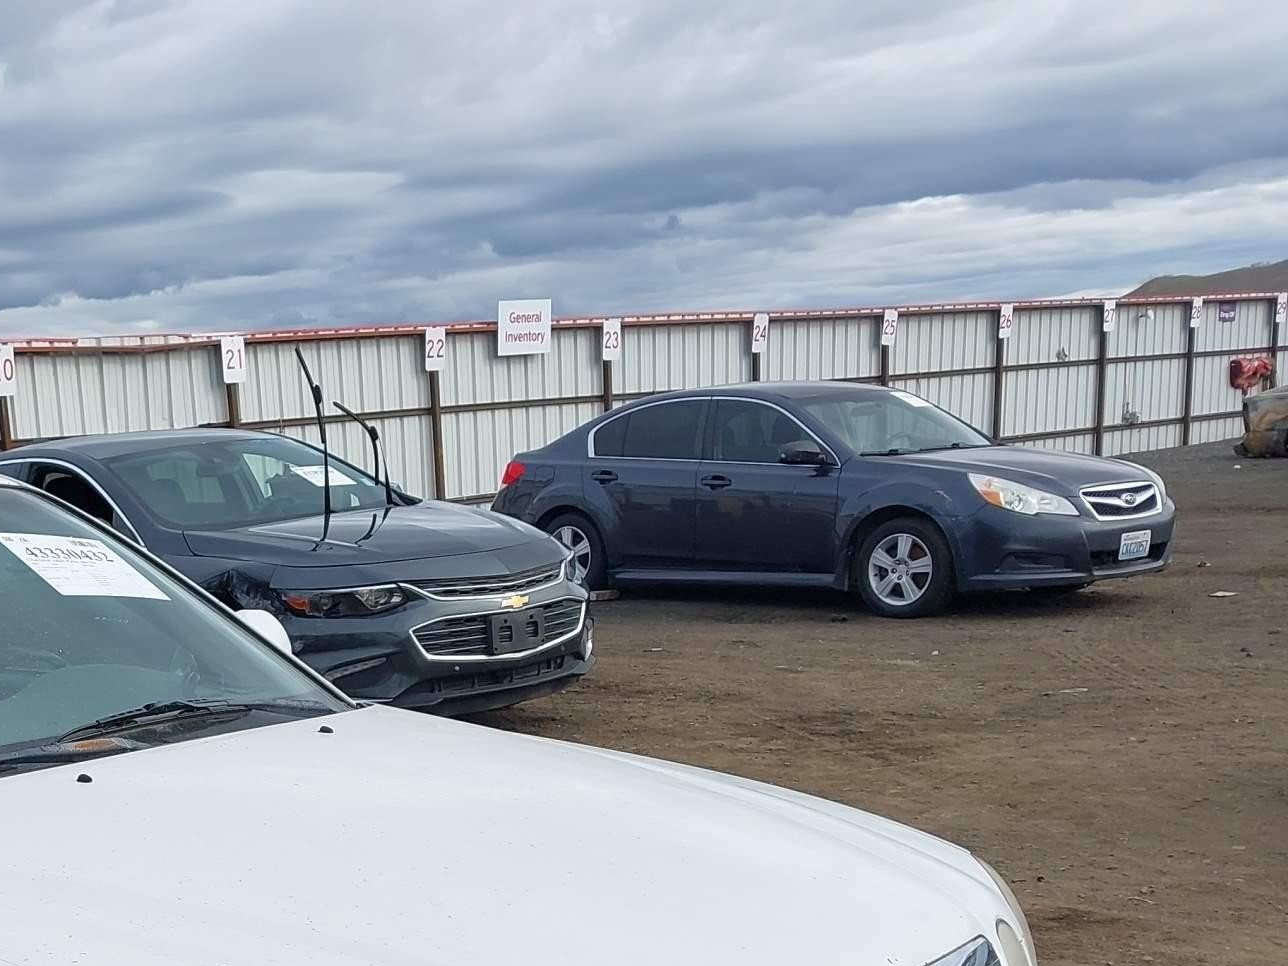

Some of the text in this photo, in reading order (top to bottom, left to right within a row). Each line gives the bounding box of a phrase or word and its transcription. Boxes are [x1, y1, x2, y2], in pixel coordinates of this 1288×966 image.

[509, 311, 542, 324] General
[999, 314, 1012, 329] 26
[1104, 308, 1115, 322] 27
[754, 324, 767, 342] 24
[883, 319, 896, 336] 25
[504, 331, 546, 344] Inventory
[604, 331, 619, 349] 23
[427, 339, 445, 359] 22
[225, 348, 243, 370] 21
[24, 546, 115, 563] 43330432
